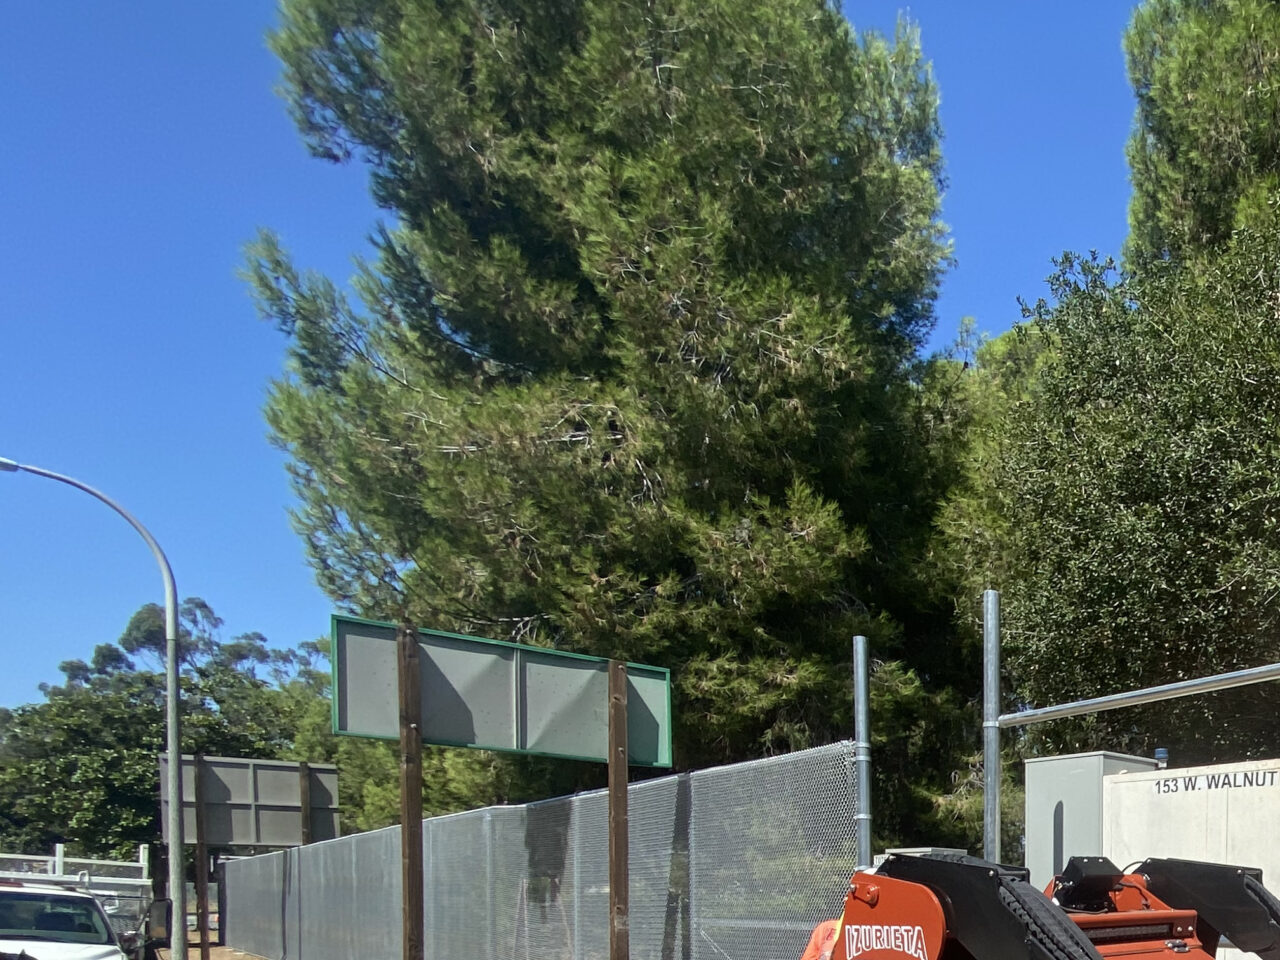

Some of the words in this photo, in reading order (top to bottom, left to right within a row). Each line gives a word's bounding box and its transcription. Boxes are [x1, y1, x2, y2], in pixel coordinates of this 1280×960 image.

[1154, 778, 1179, 794] 153
[1183, 776, 1201, 791] W.
[1206, 770, 1279, 790] WALNUT
